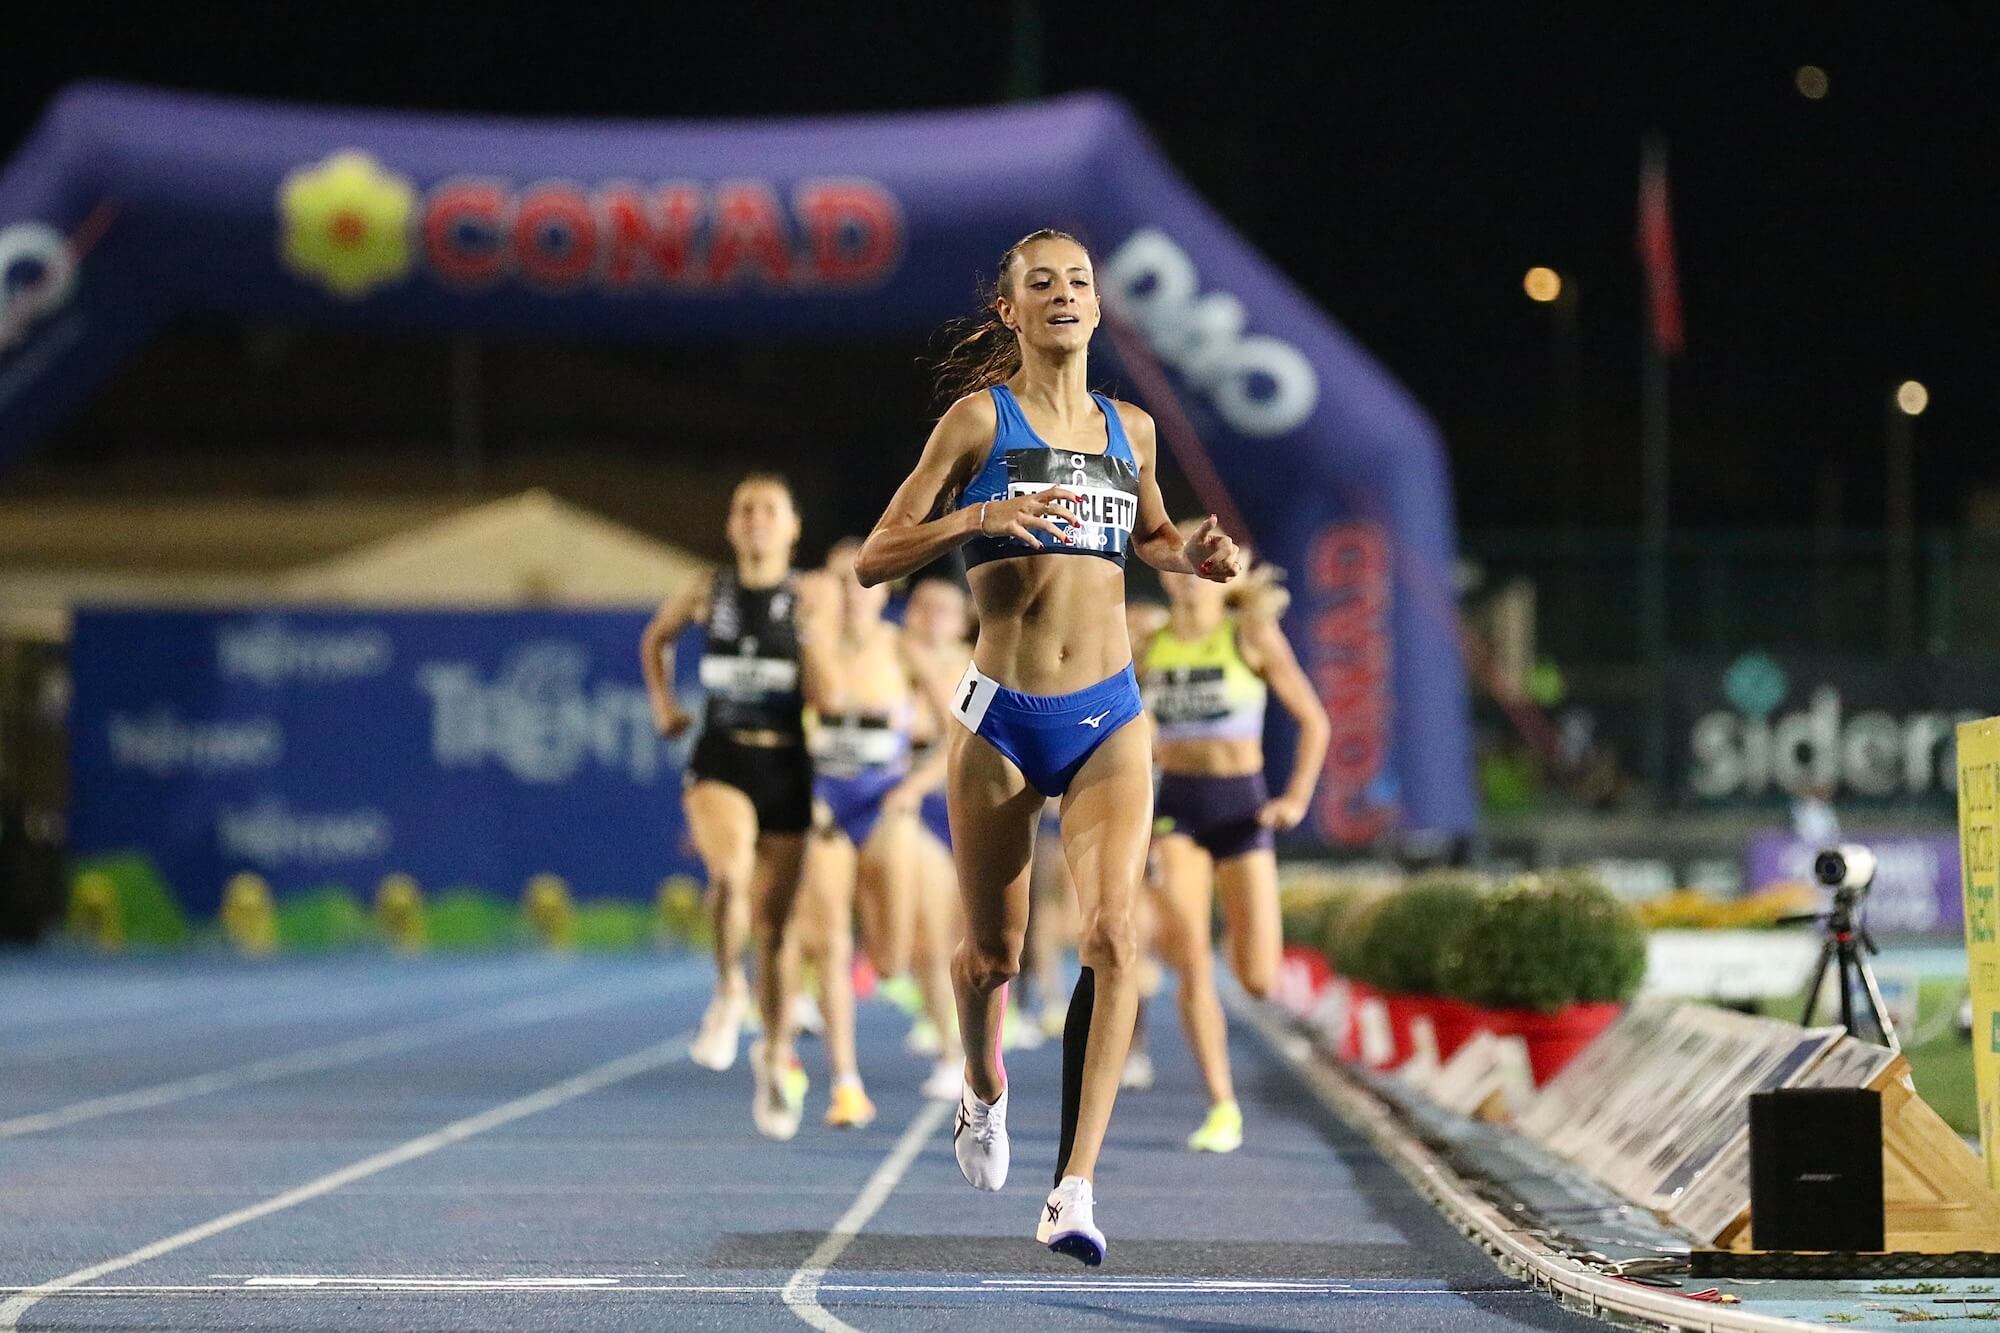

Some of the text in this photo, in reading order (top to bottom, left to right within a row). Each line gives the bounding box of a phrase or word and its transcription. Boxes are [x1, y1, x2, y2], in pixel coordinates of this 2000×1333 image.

[422, 175, 904, 290] CONAD
[960, 680, 978, 713] 1
[1312, 522, 1396, 846] CONAD
